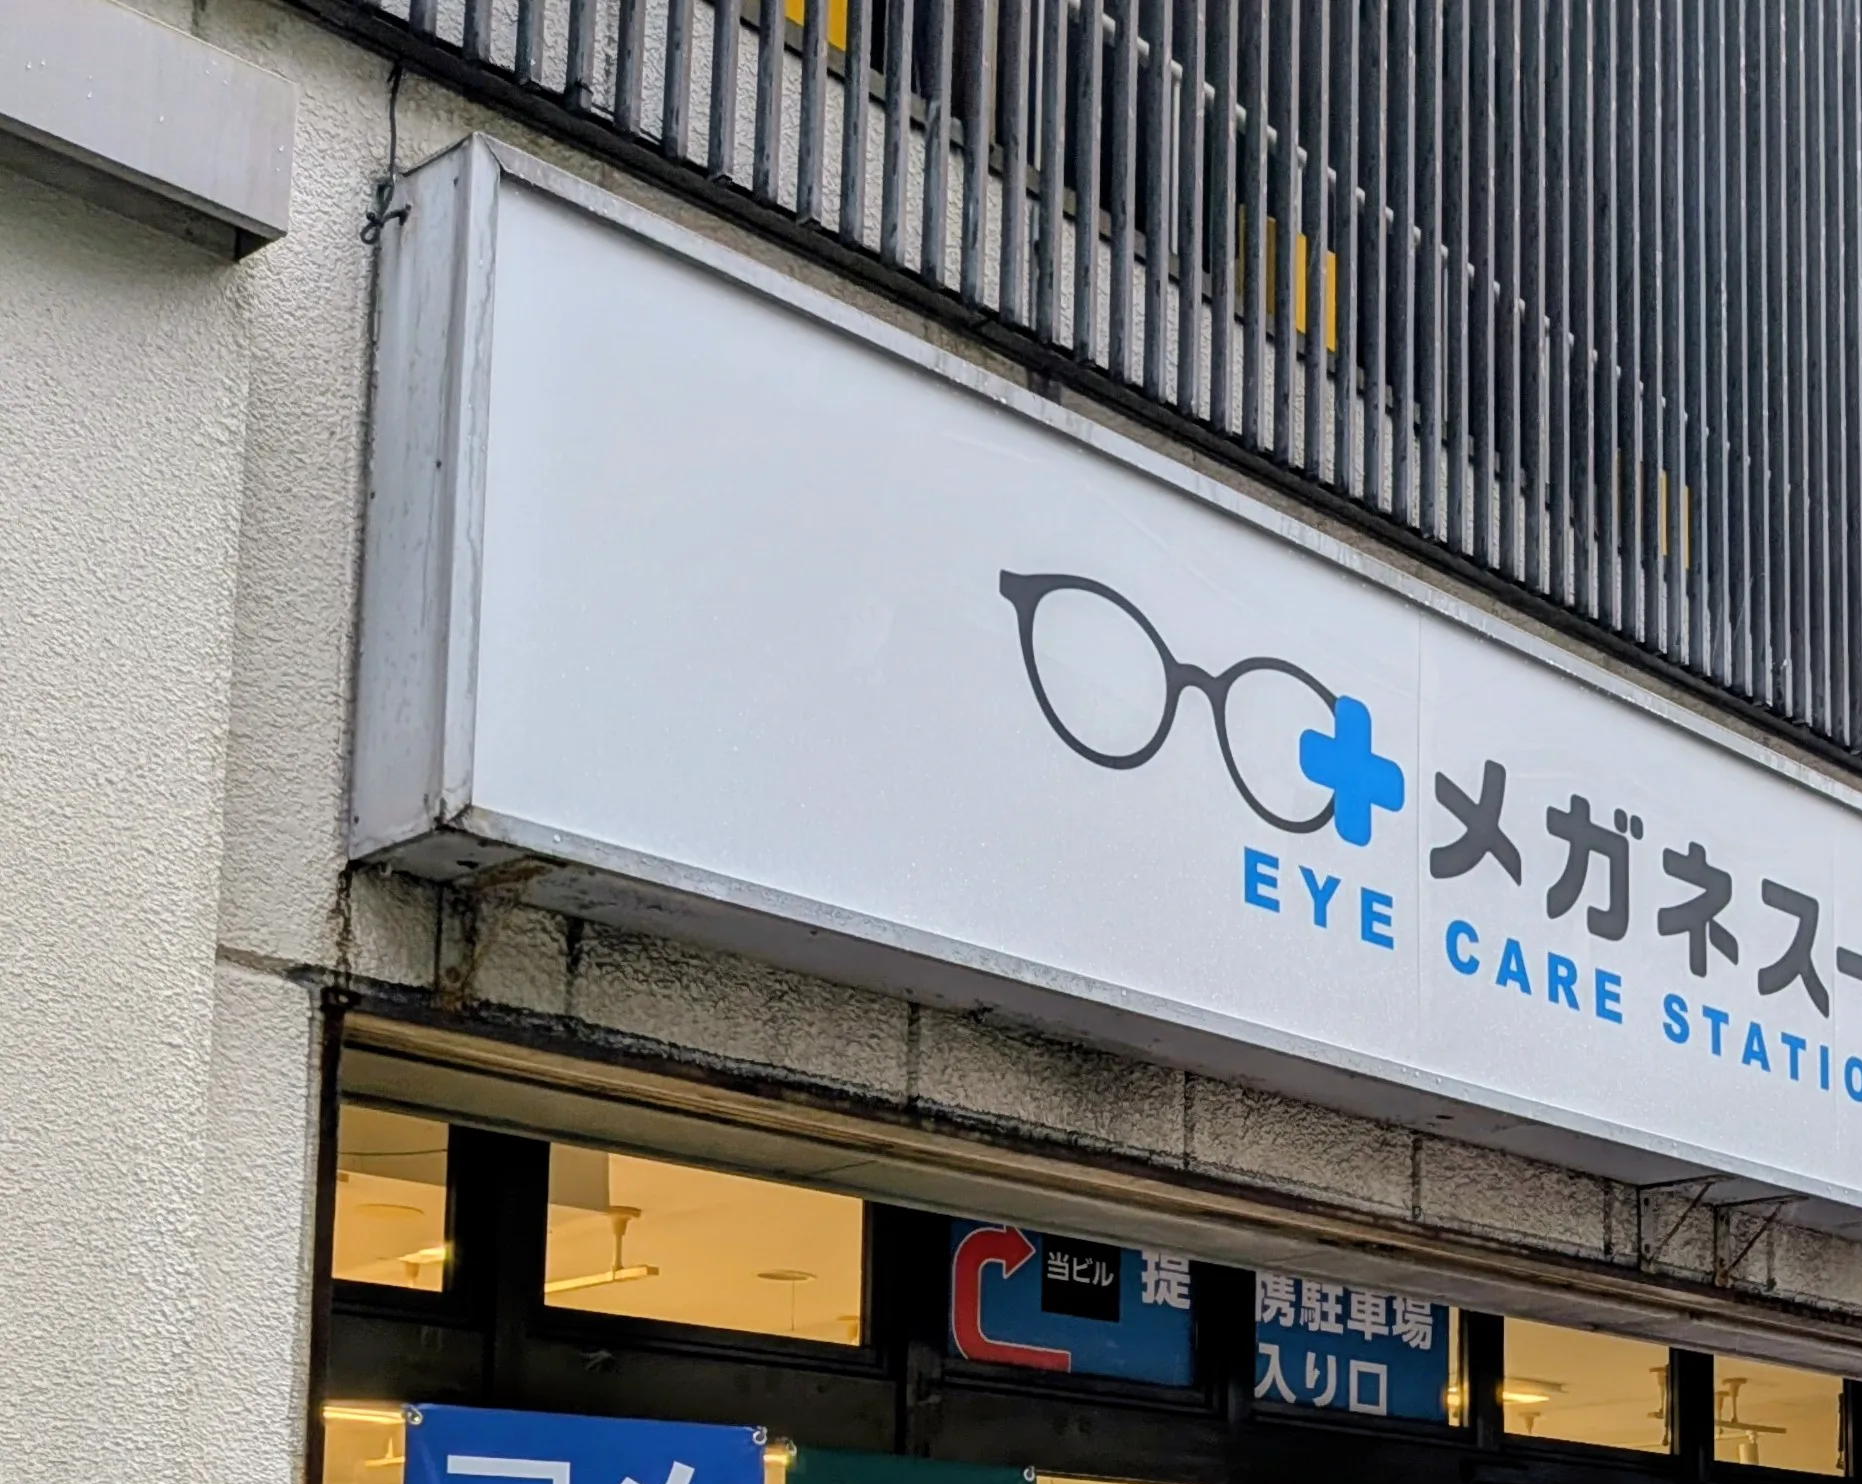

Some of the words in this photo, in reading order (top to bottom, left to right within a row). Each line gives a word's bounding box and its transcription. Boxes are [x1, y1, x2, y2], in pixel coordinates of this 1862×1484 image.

[1244, 847, 1395, 950] EYE
[1445, 920, 1624, 1023] CARE
[1047, 1250, 1114, 1287] 当ビル
[1254, 1343, 1388, 1417] 入り口
